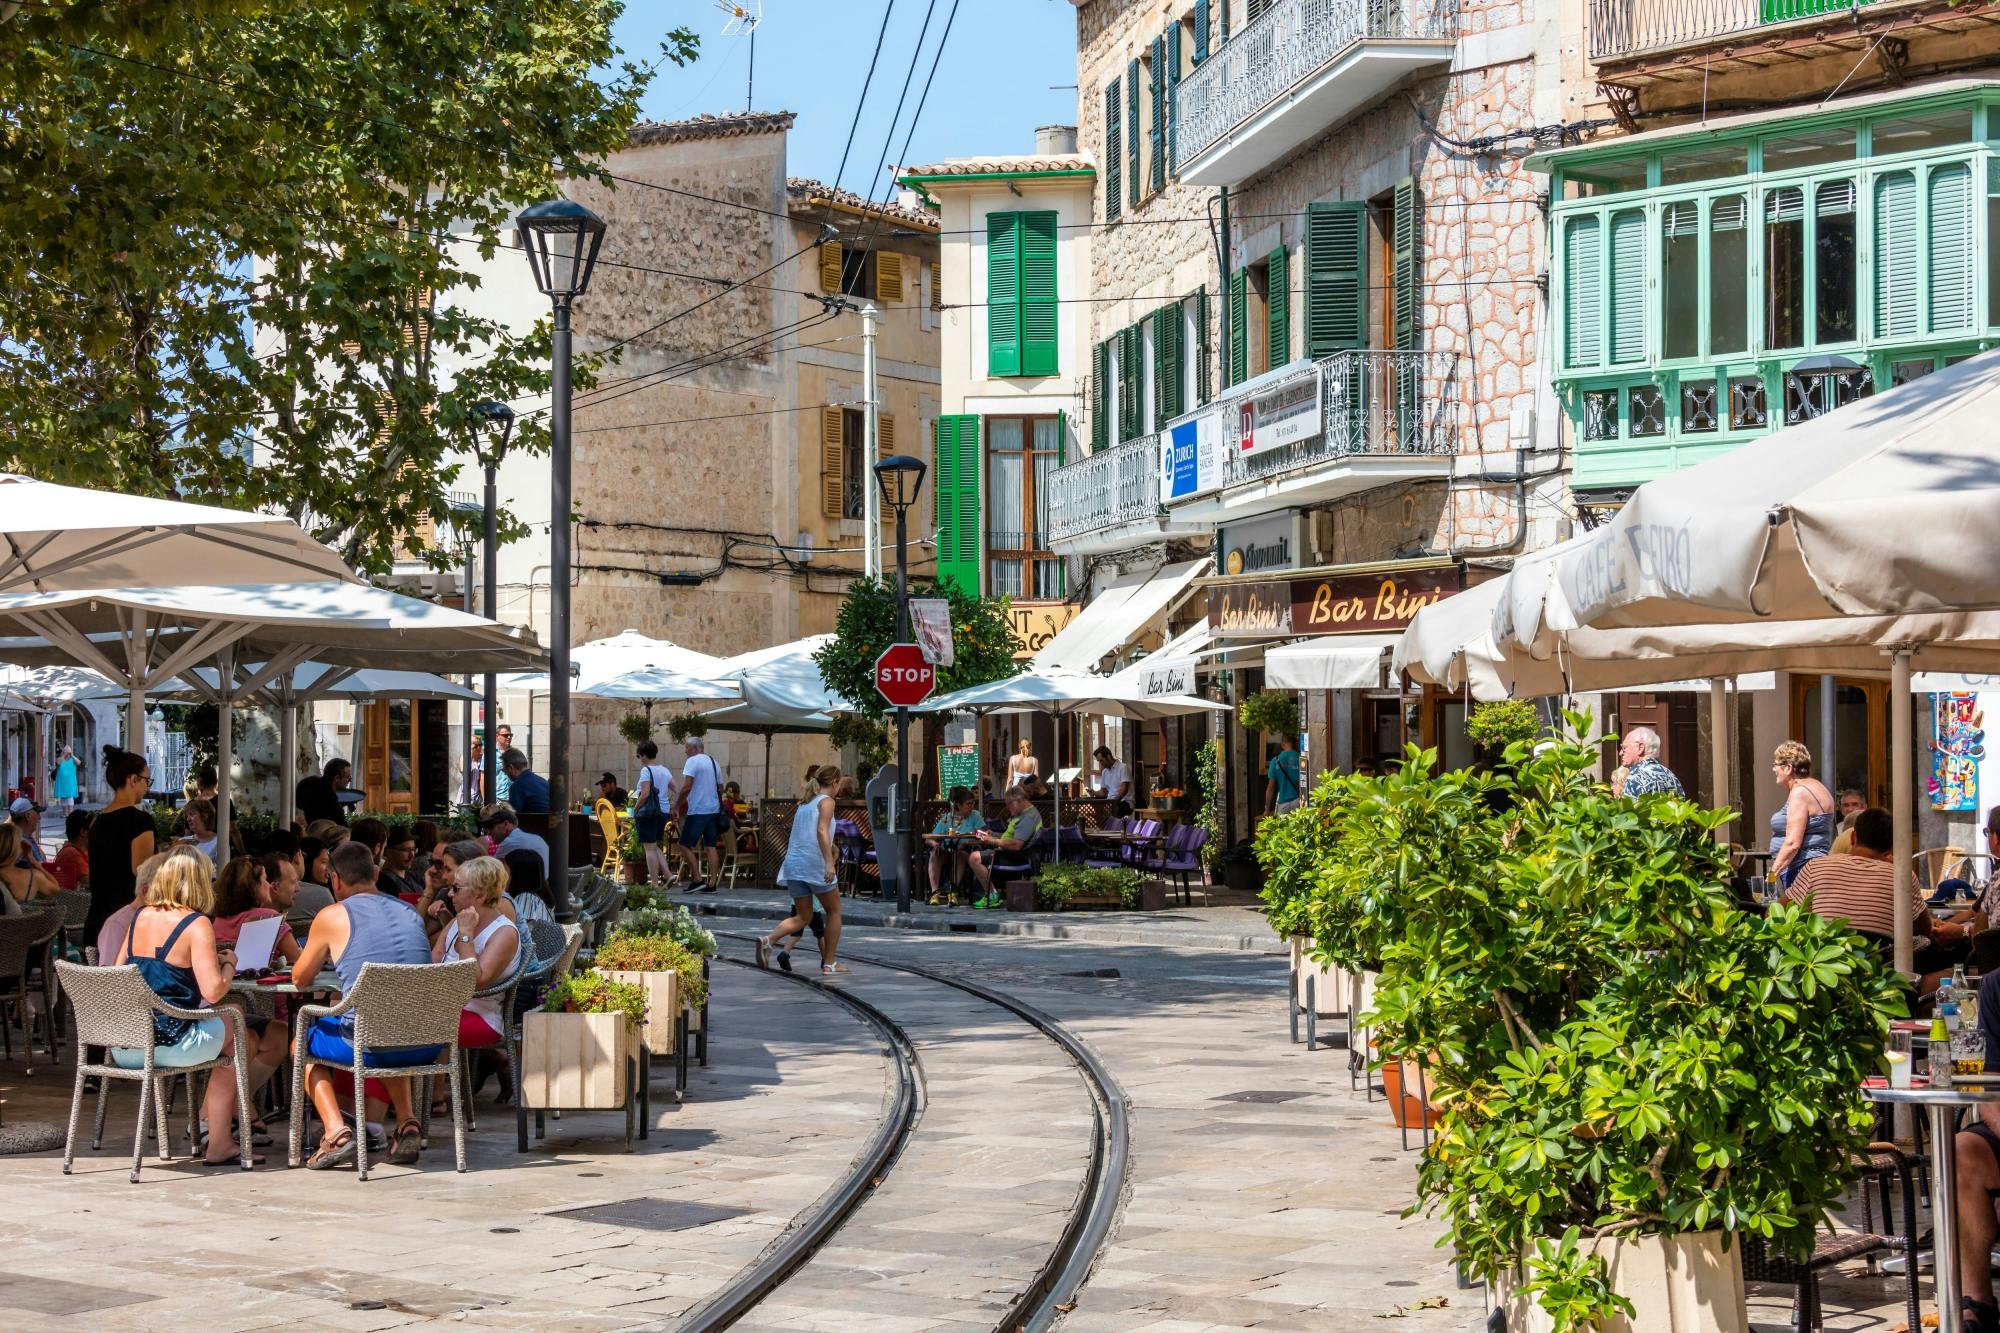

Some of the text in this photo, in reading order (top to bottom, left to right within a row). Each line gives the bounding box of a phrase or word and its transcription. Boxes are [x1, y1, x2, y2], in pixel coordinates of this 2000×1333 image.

[1175, 443, 1194, 463] ZURICH
[1220, 593, 1245, 631] Bar
[1309, 579, 1441, 624] Bar Bini
[880, 667, 931, 683] STOP
[1147, 668, 1185, 695] Bar Bini
